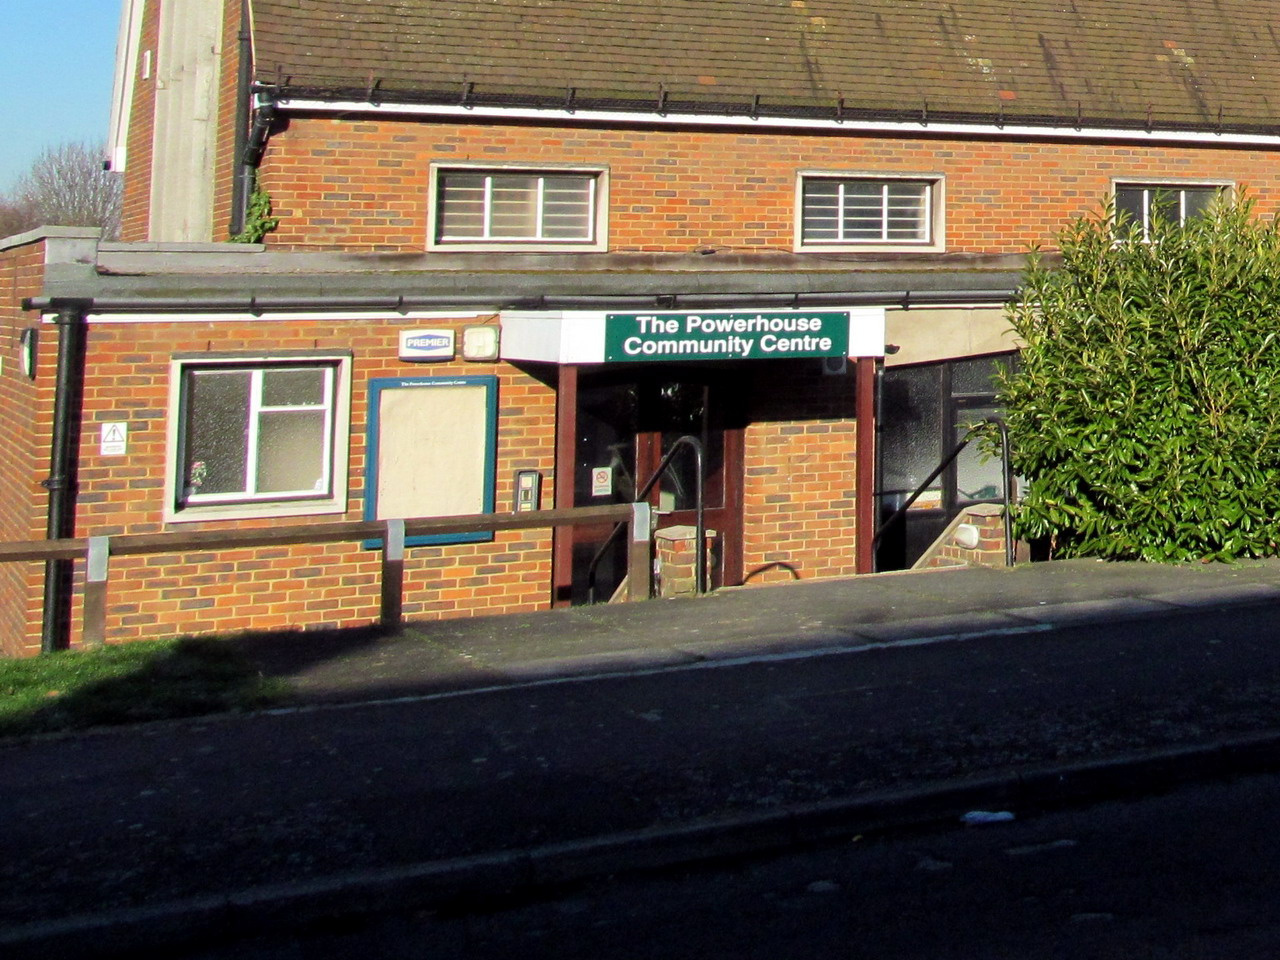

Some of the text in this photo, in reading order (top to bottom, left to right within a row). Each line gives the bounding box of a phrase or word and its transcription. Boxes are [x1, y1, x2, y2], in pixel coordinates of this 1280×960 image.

[635, 314, 822, 333] The Powerhouse
[407, 338, 449, 347] PREMIER
[623, 334, 832, 356] Community Centre
